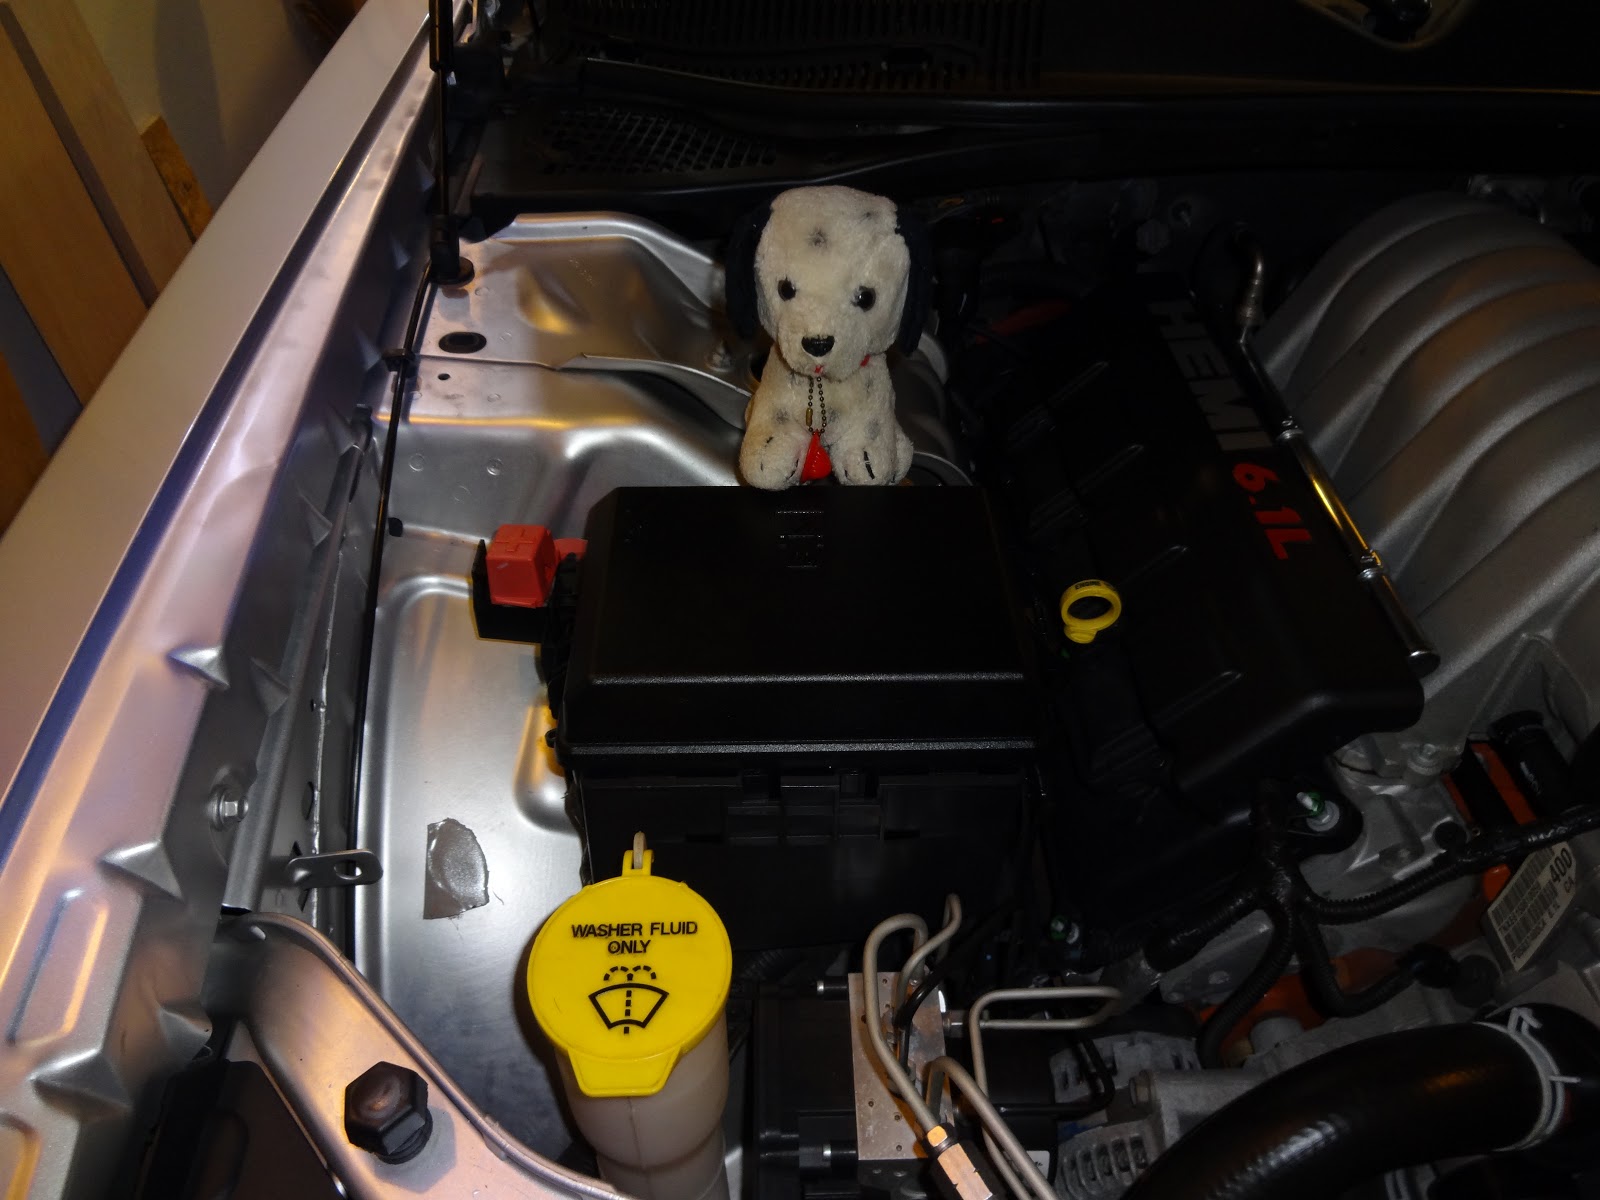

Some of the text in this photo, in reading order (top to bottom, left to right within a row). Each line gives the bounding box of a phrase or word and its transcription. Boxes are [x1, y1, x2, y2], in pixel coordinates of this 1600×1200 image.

[1146, 299, 1312, 560] HEMI 6.1L
[1549, 847, 1573, 883] 400
[571, 921, 698, 938] WASHER FLUID
[608, 940, 651, 954] ONLY
